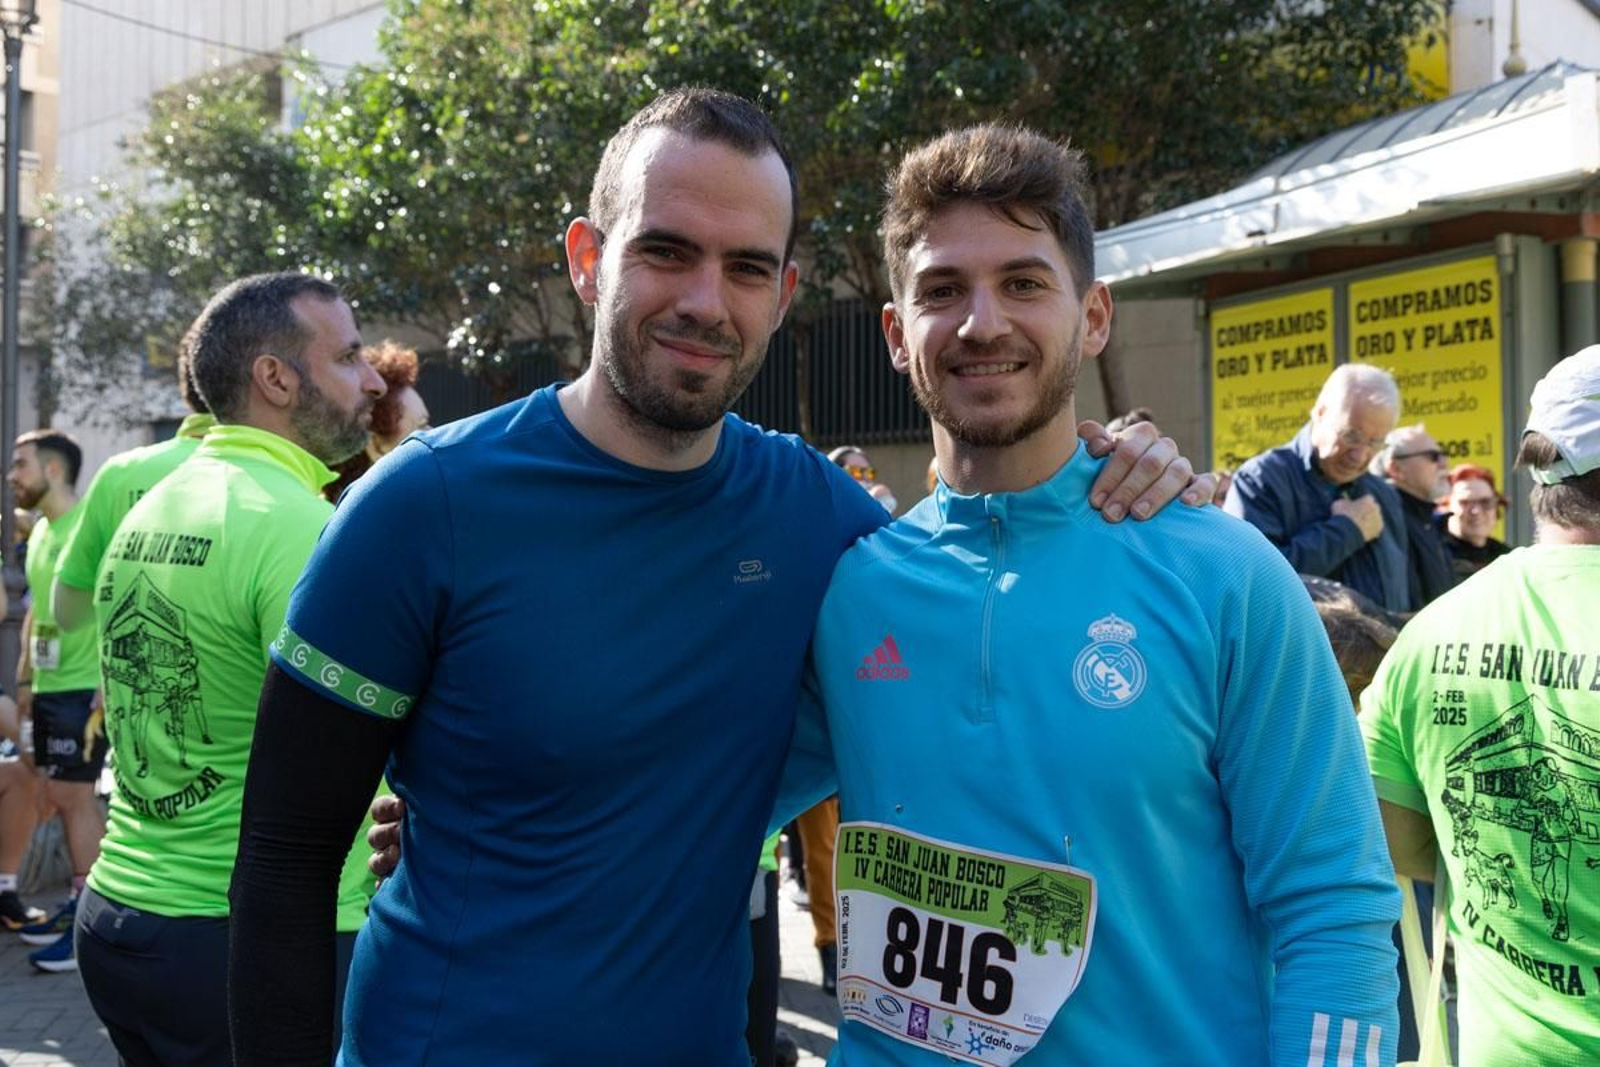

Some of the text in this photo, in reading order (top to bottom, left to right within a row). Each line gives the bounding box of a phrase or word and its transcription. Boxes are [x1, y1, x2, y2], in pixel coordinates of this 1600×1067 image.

[1356, 279, 1492, 324] COMPRAMOS
[1216, 309, 1327, 348] COMPRAMOS
[1356, 316, 1494, 358] ORO Y PLATA
[1216, 343, 1328, 379] ORO Y PLATA
[1397, 364, 1488, 394] ejor precio
[1237, 388, 1276, 409] mejor
[856, 666, 910, 681] adidas
[1431, 643, 1471, 676] I.E.S.
[1479, 643, 1524, 682] SAN
[1433, 707, 1467, 725] 2025
[844, 831, 1006, 889] I.E.S. SAN JUAN BOSCO
[854, 857, 990, 912] IV CARRERA POPULAR
[841, 895, 850, 918] 2025
[882, 906, 1017, 1016] 846
[1482, 923, 1586, 996] CARRERA
[984, 1034, 1013, 1050] daño
